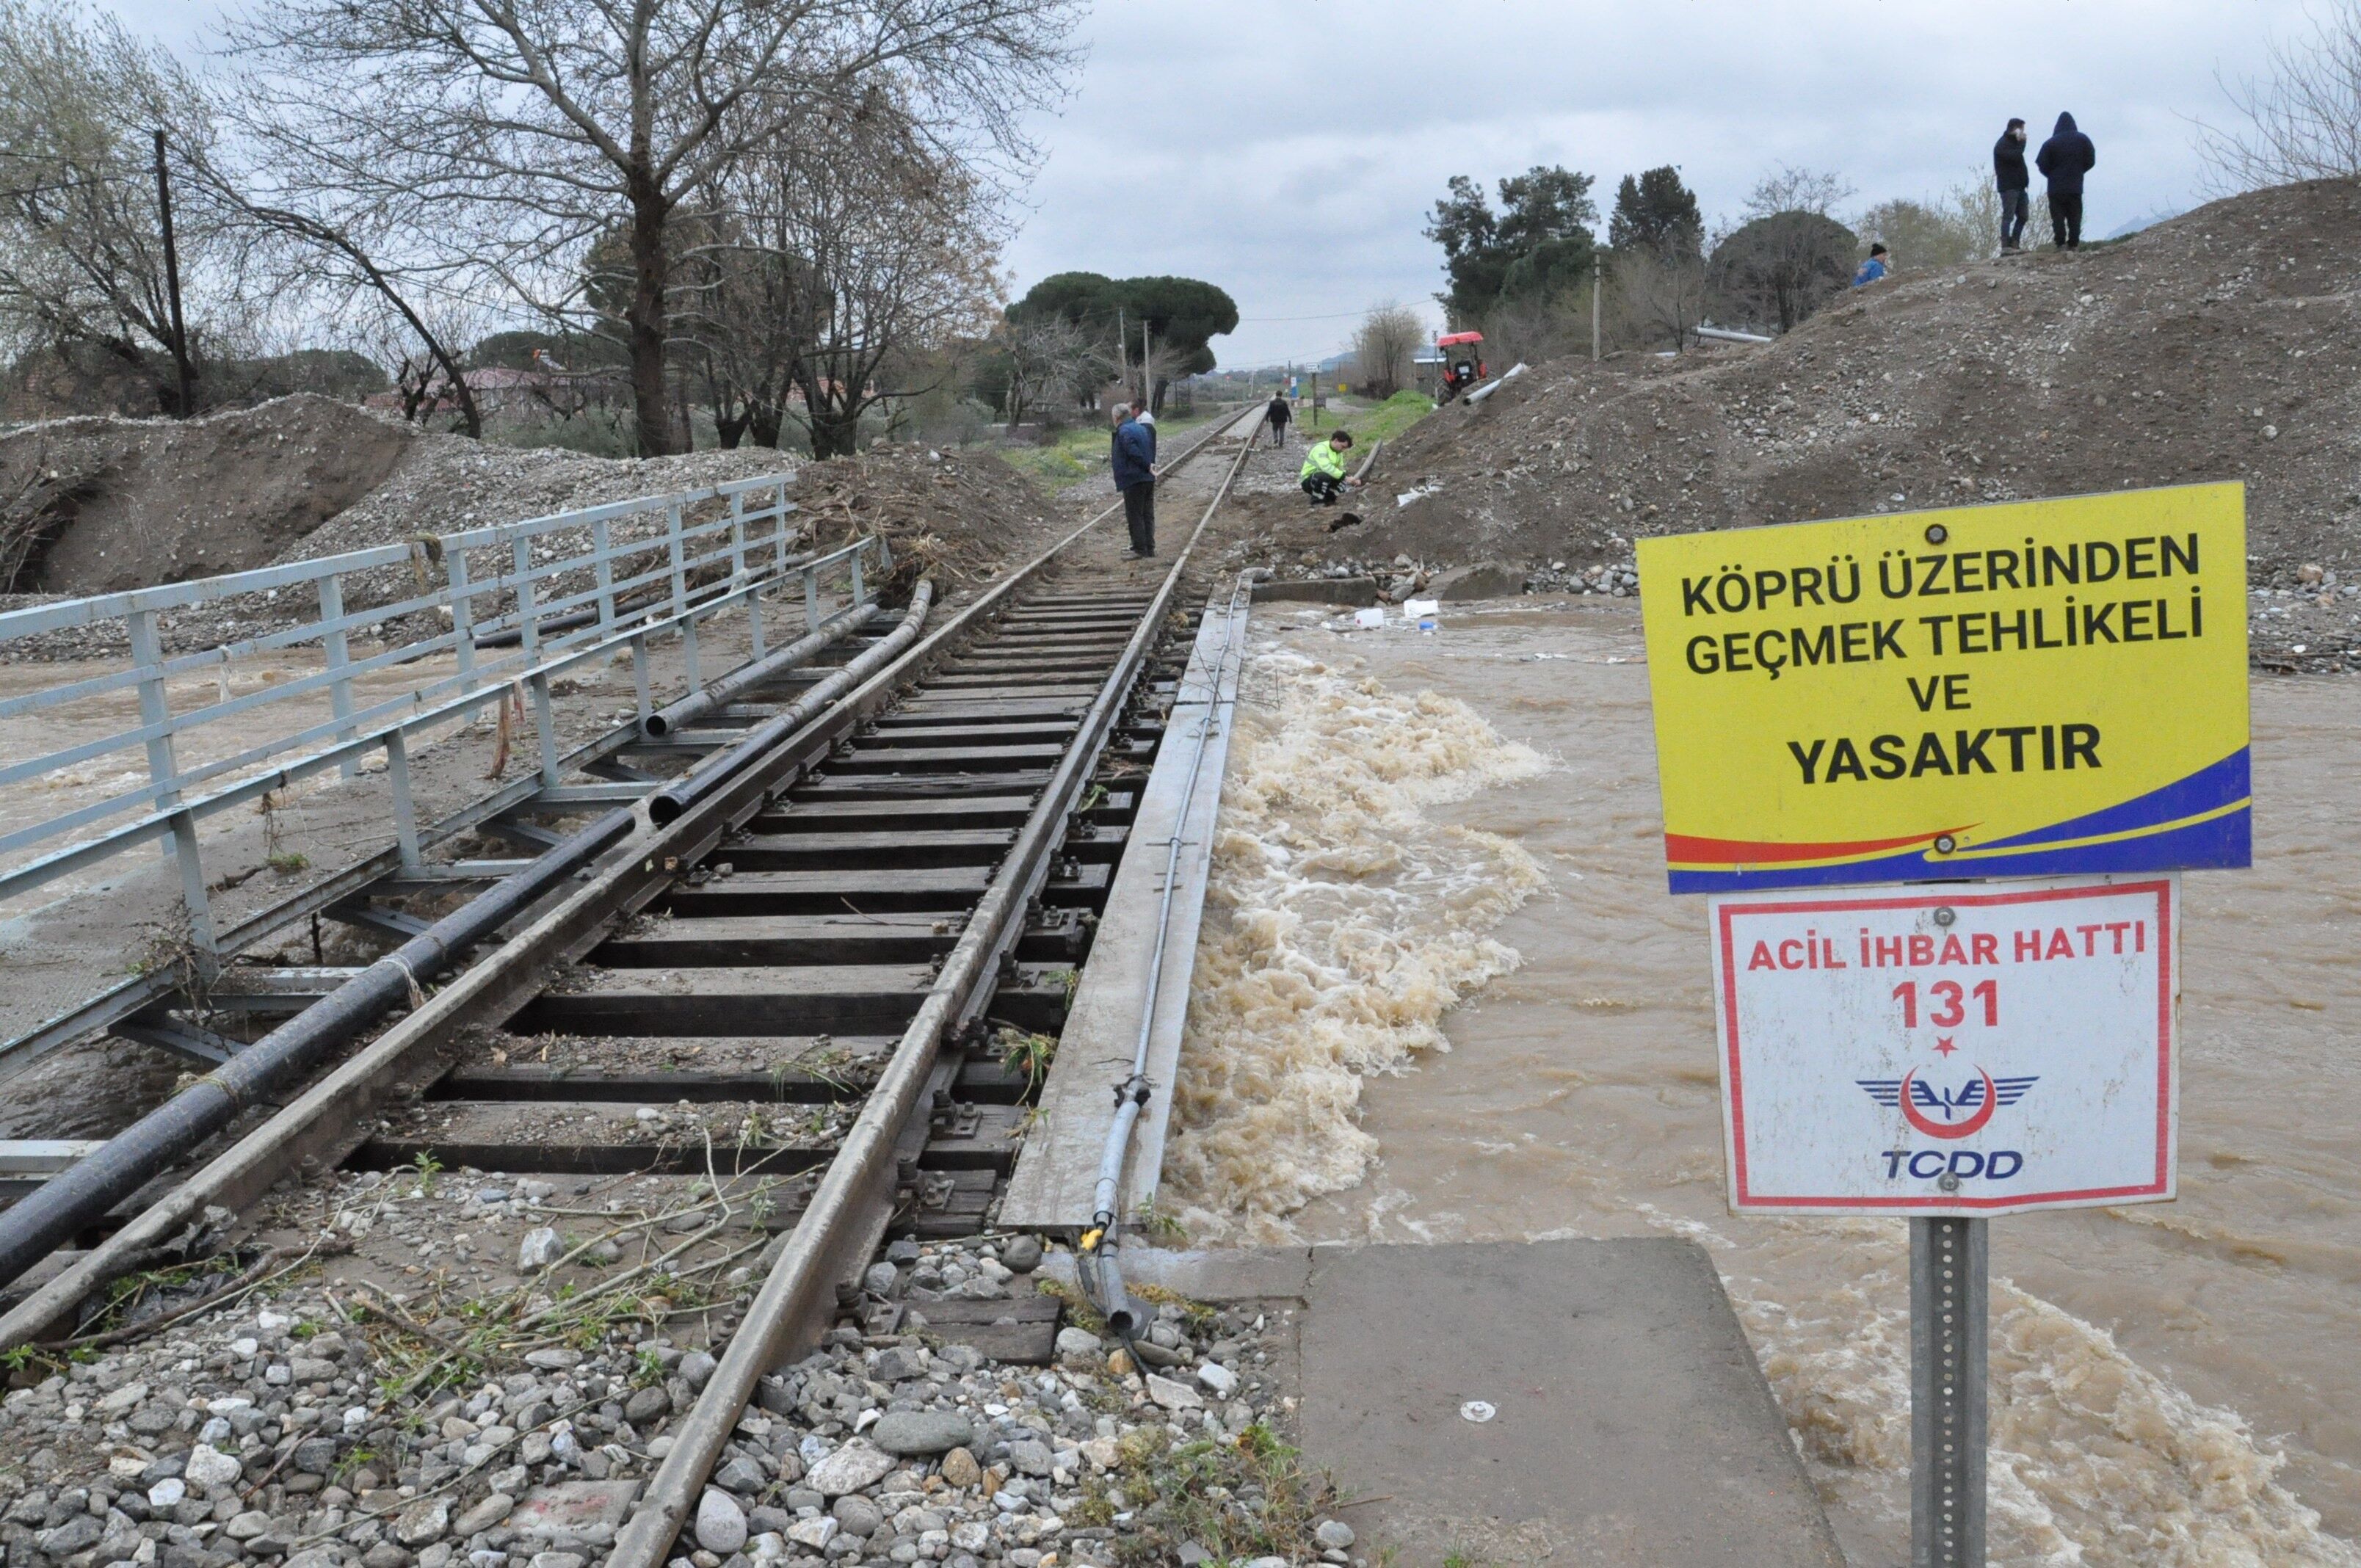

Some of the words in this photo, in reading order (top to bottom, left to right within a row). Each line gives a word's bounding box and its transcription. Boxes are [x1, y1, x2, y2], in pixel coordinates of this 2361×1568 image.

[1681, 554, 1860, 617] KÖPRÜ
[1878, 532, 2199, 600] ÜZERİNDEN
[1685, 618, 1909, 680] GEÇMEK
[1918, 585, 2203, 656] TEHLİKELİ
[1906, 673, 1973, 712] VE
[1785, 723, 2103, 785] YASAKTIR
[1747, 929, 1847, 970] ACİL
[1860, 927, 2000, 968] İHBAR
[2014, 920, 2146, 963] HATTI
[1892, 979, 1998, 1028] 131
[1880, 1150, 2024, 1180] TCDD
